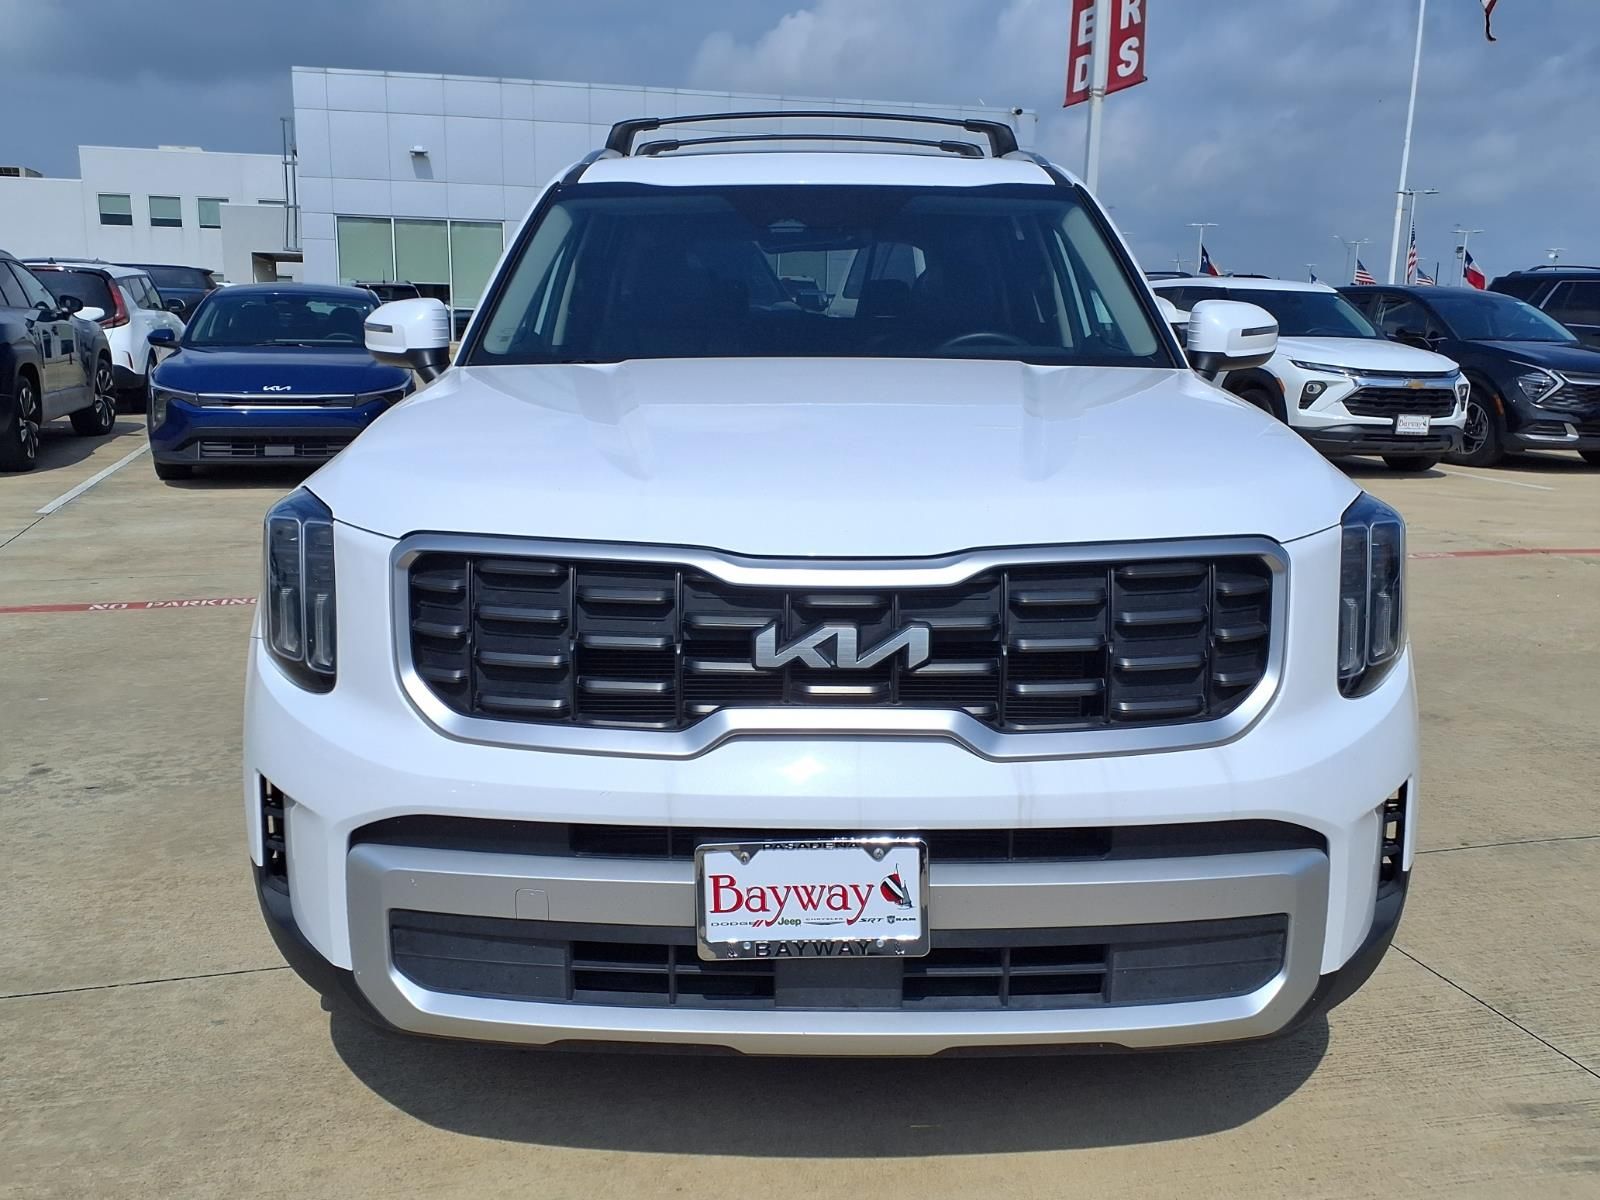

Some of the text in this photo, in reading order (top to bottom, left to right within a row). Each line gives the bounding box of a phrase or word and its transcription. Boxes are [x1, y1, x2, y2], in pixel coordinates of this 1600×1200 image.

[753, 622, 931, 670] KIA
[763, 842, 858, 850] PASADENA
[709, 875, 874, 927] Bayway
[777, 917, 802, 926] Jeep
[755, 940, 872, 957] BAYWAY
